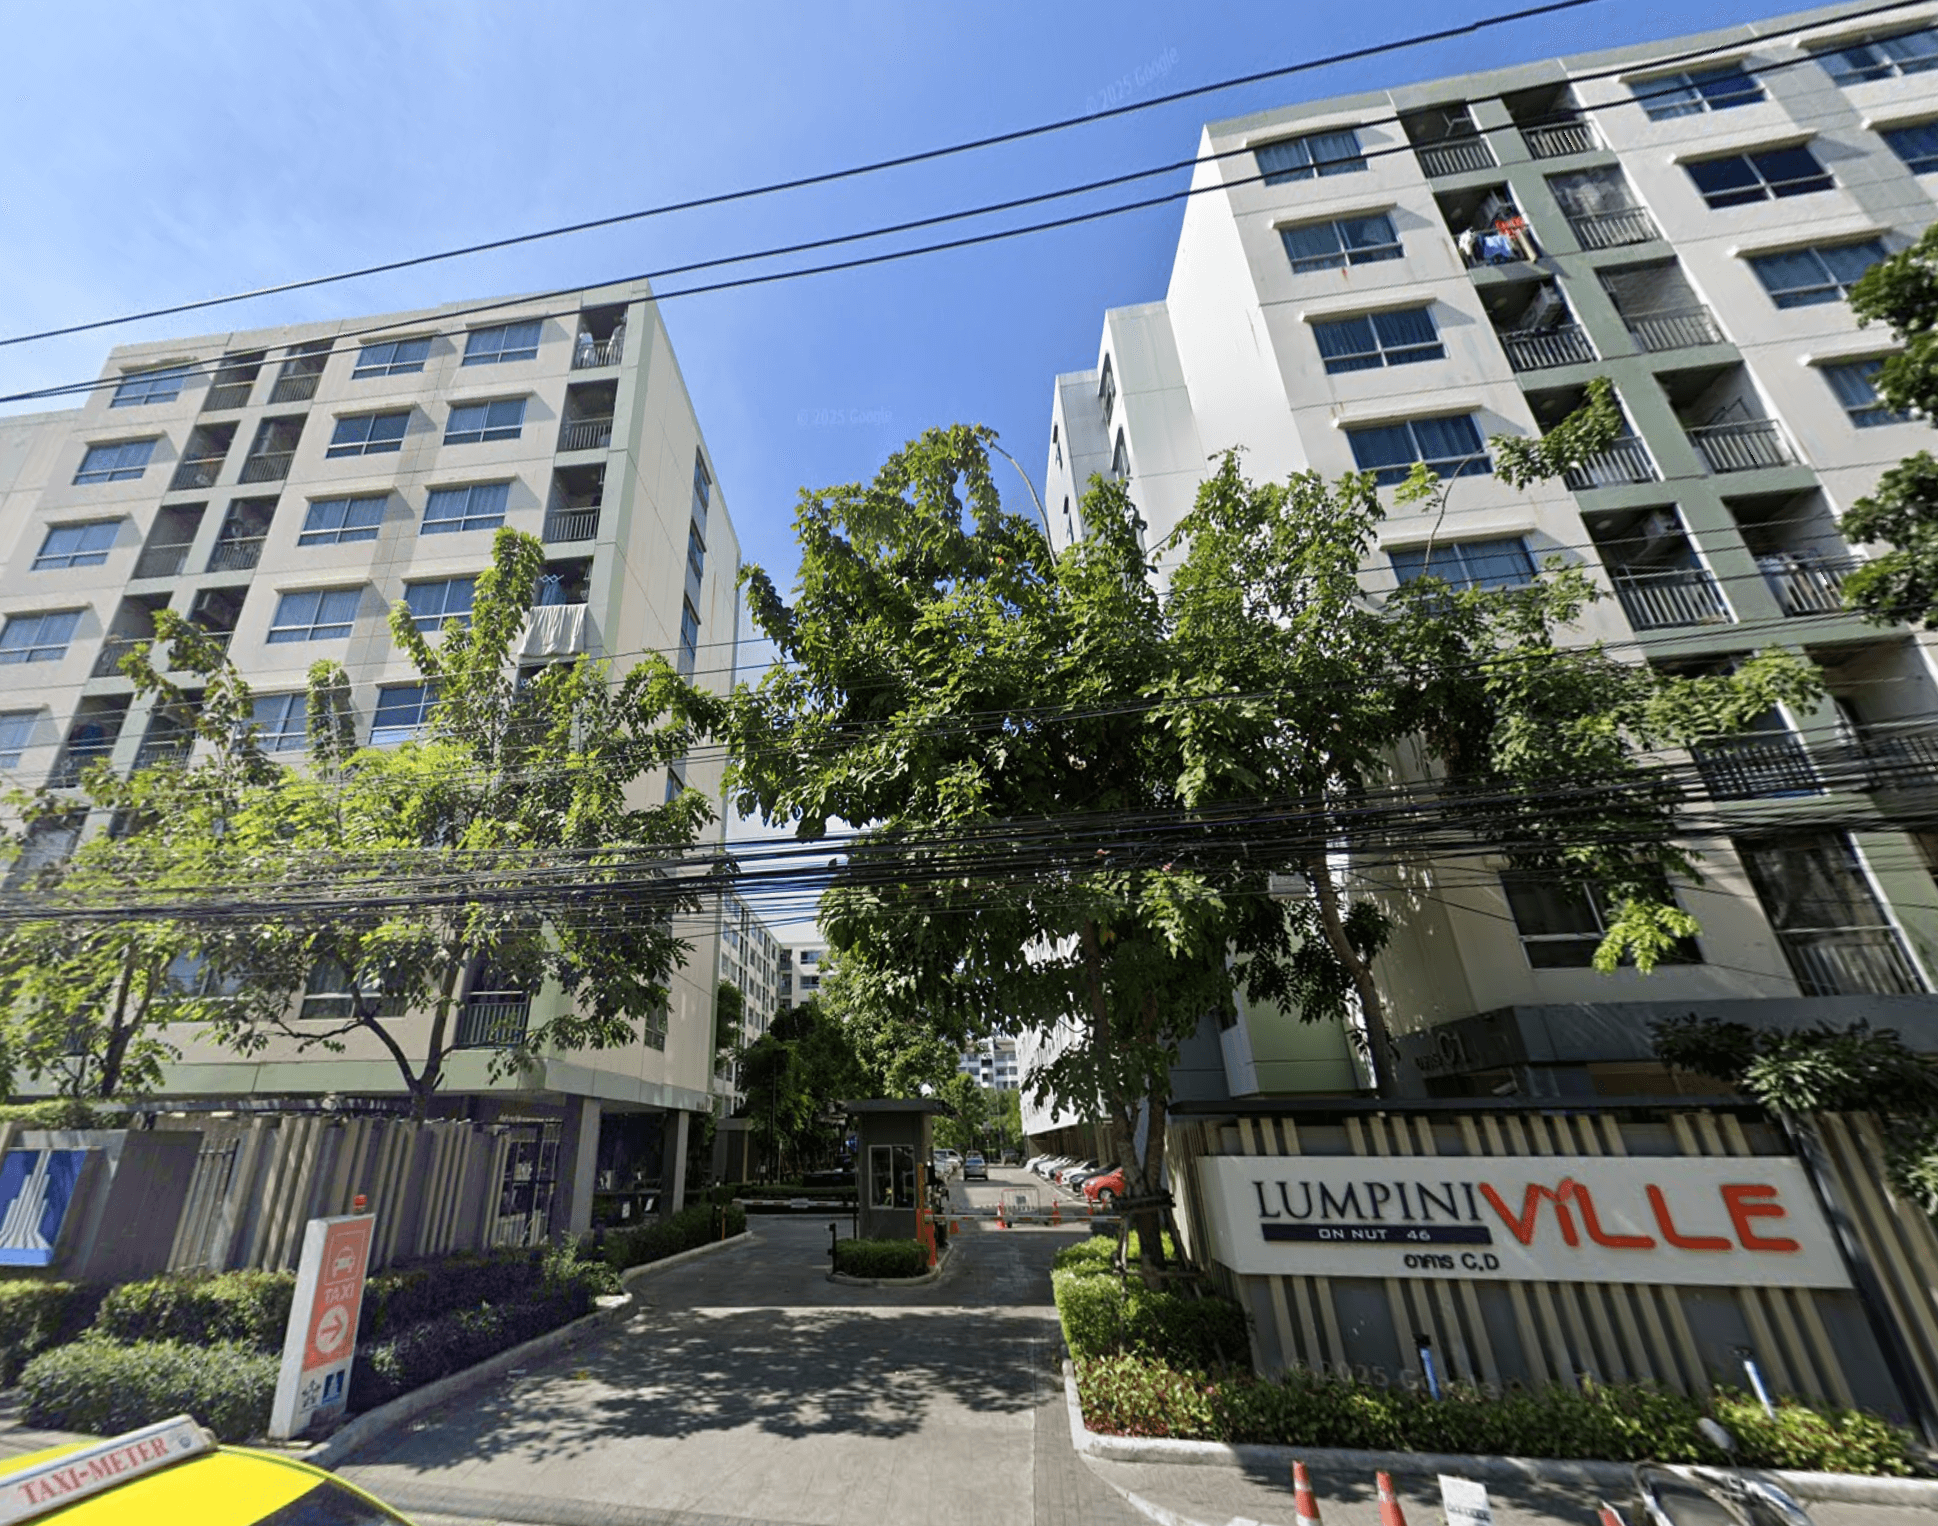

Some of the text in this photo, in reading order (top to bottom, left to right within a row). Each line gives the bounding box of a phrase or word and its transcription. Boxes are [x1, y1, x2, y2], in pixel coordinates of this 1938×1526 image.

[1252, 1177, 1801, 1251] LUMPINI VILLE
[1318, 1228, 1431, 1242] ON NUT 46
[324, 1282, 355, 1303] TAXI
[19, 1437, 169, 1504] TAXI-METER
